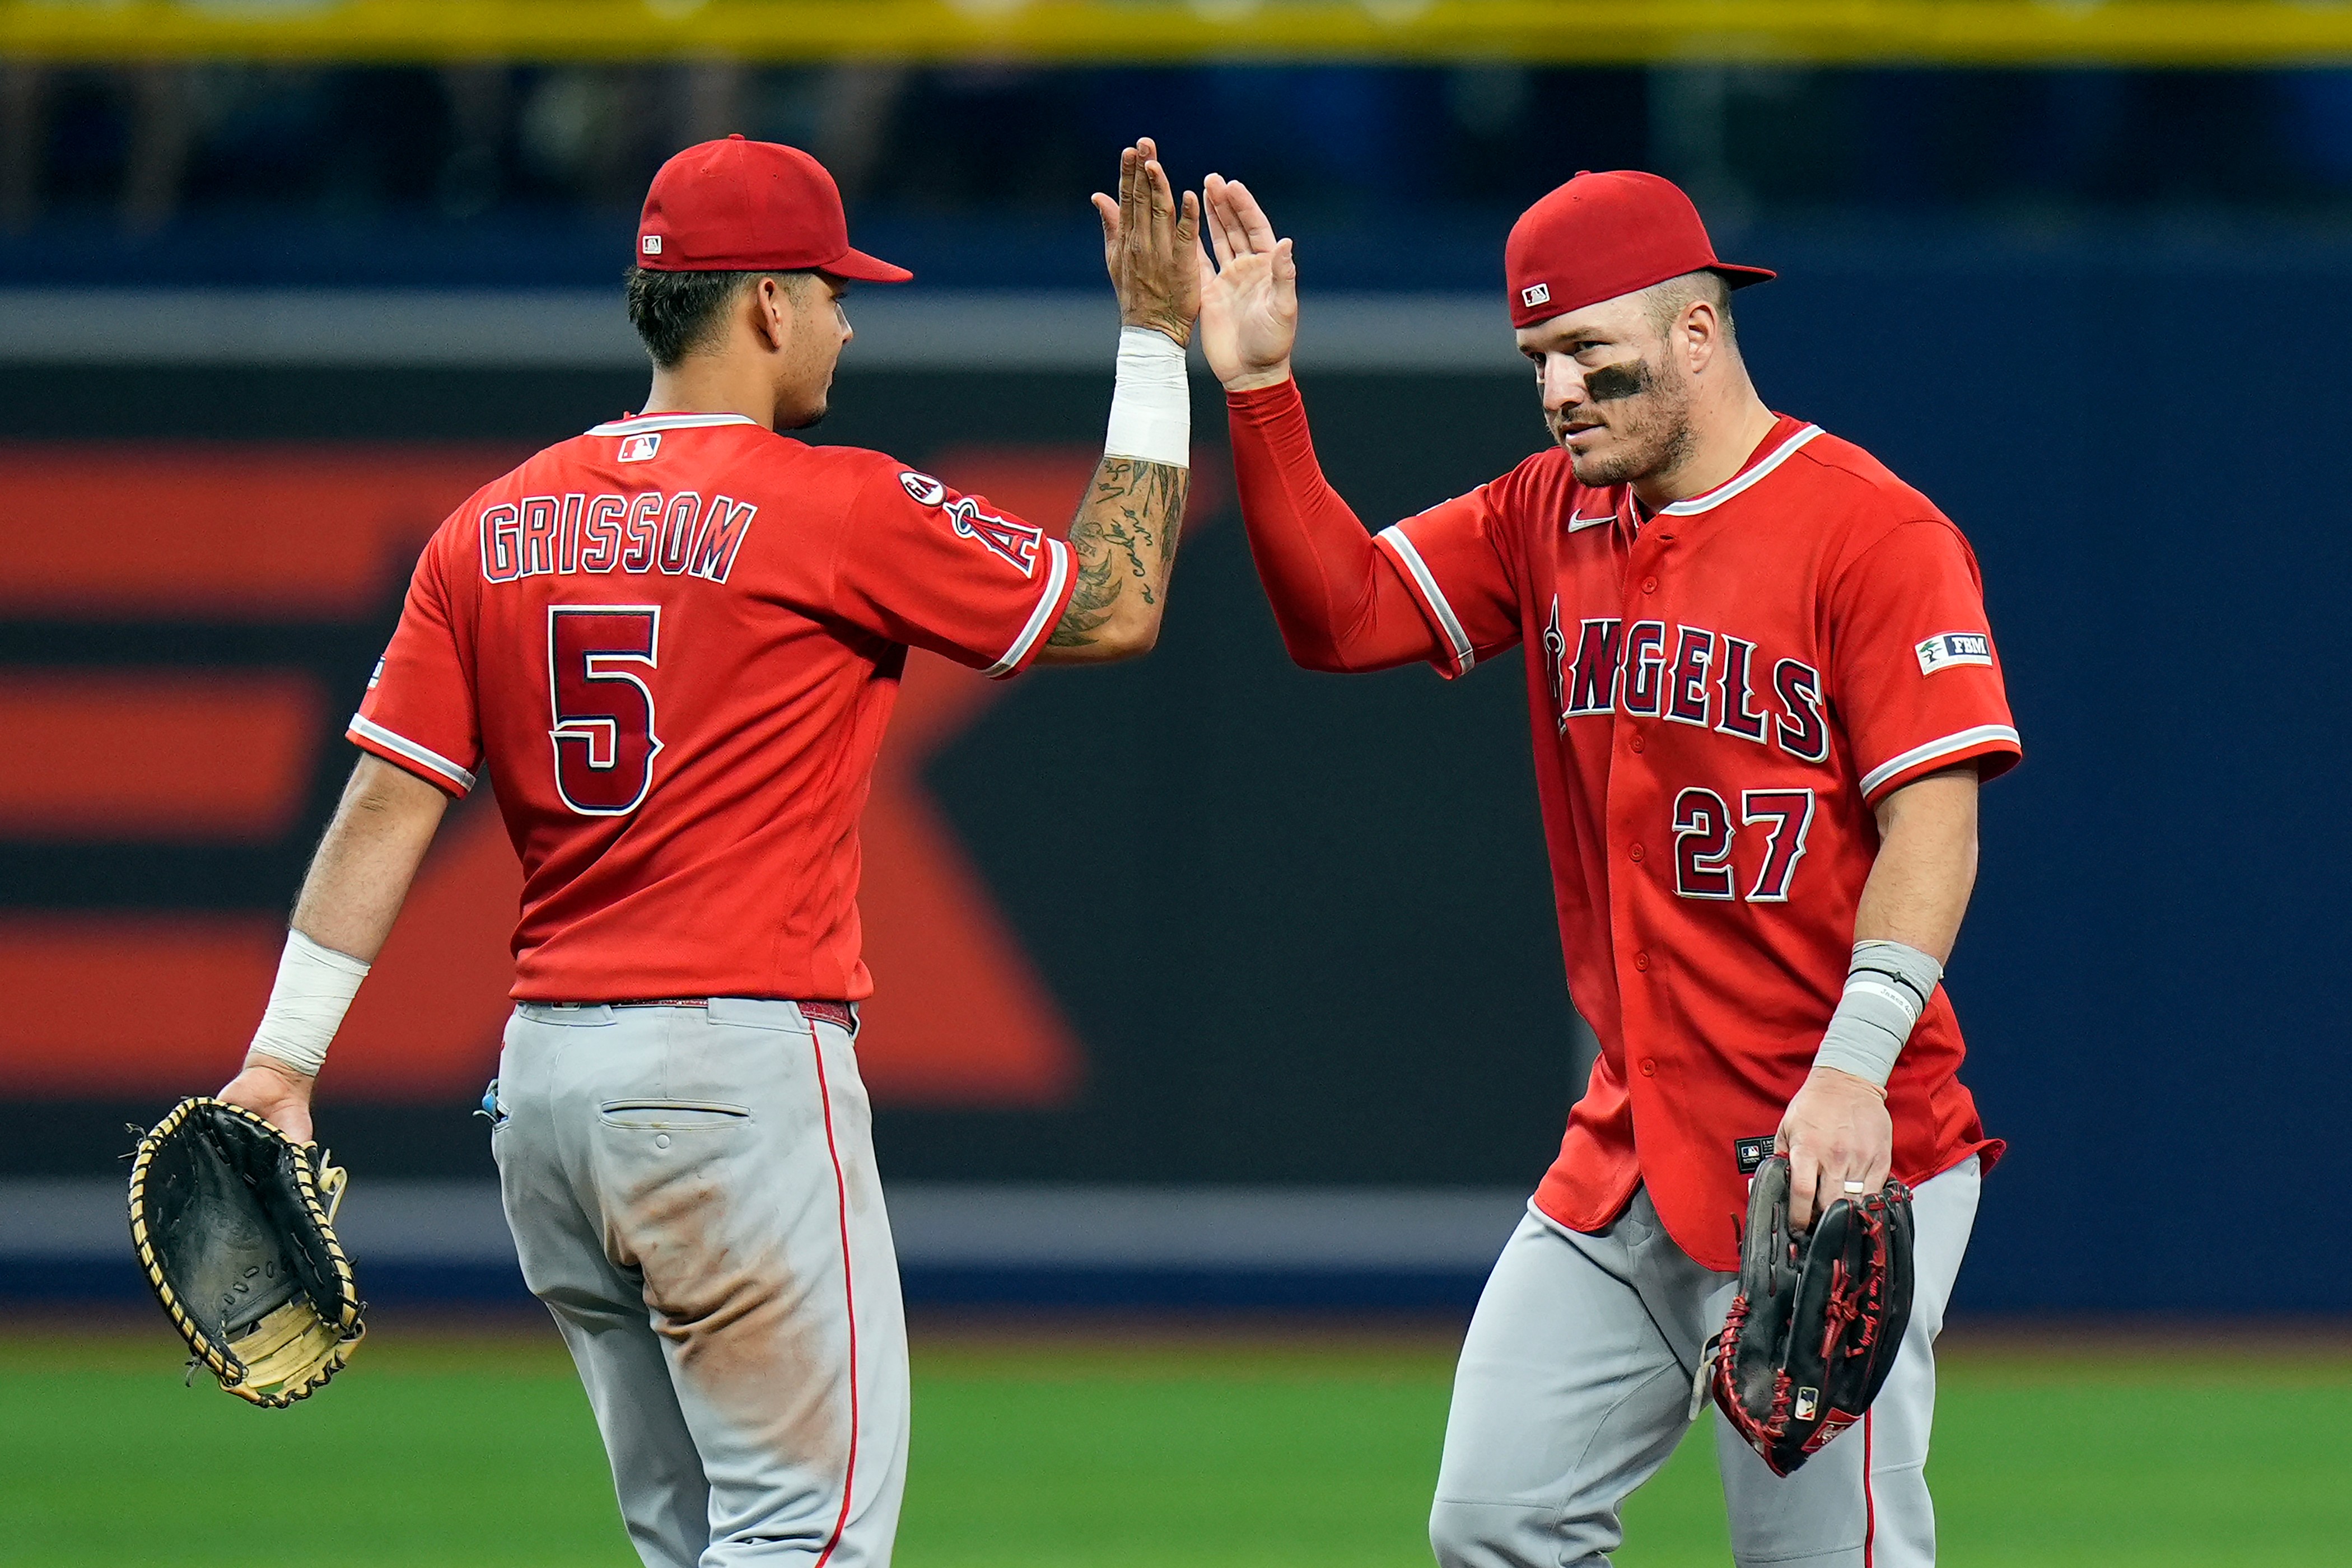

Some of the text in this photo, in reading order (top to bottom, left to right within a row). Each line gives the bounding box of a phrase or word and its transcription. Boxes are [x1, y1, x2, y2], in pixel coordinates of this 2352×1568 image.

[480, 491, 757, 585] GRISSOM
[1952, 637, 1986, 654] FBM
[548, 604, 665, 816] 5
[1672, 786, 1816, 903] 27
